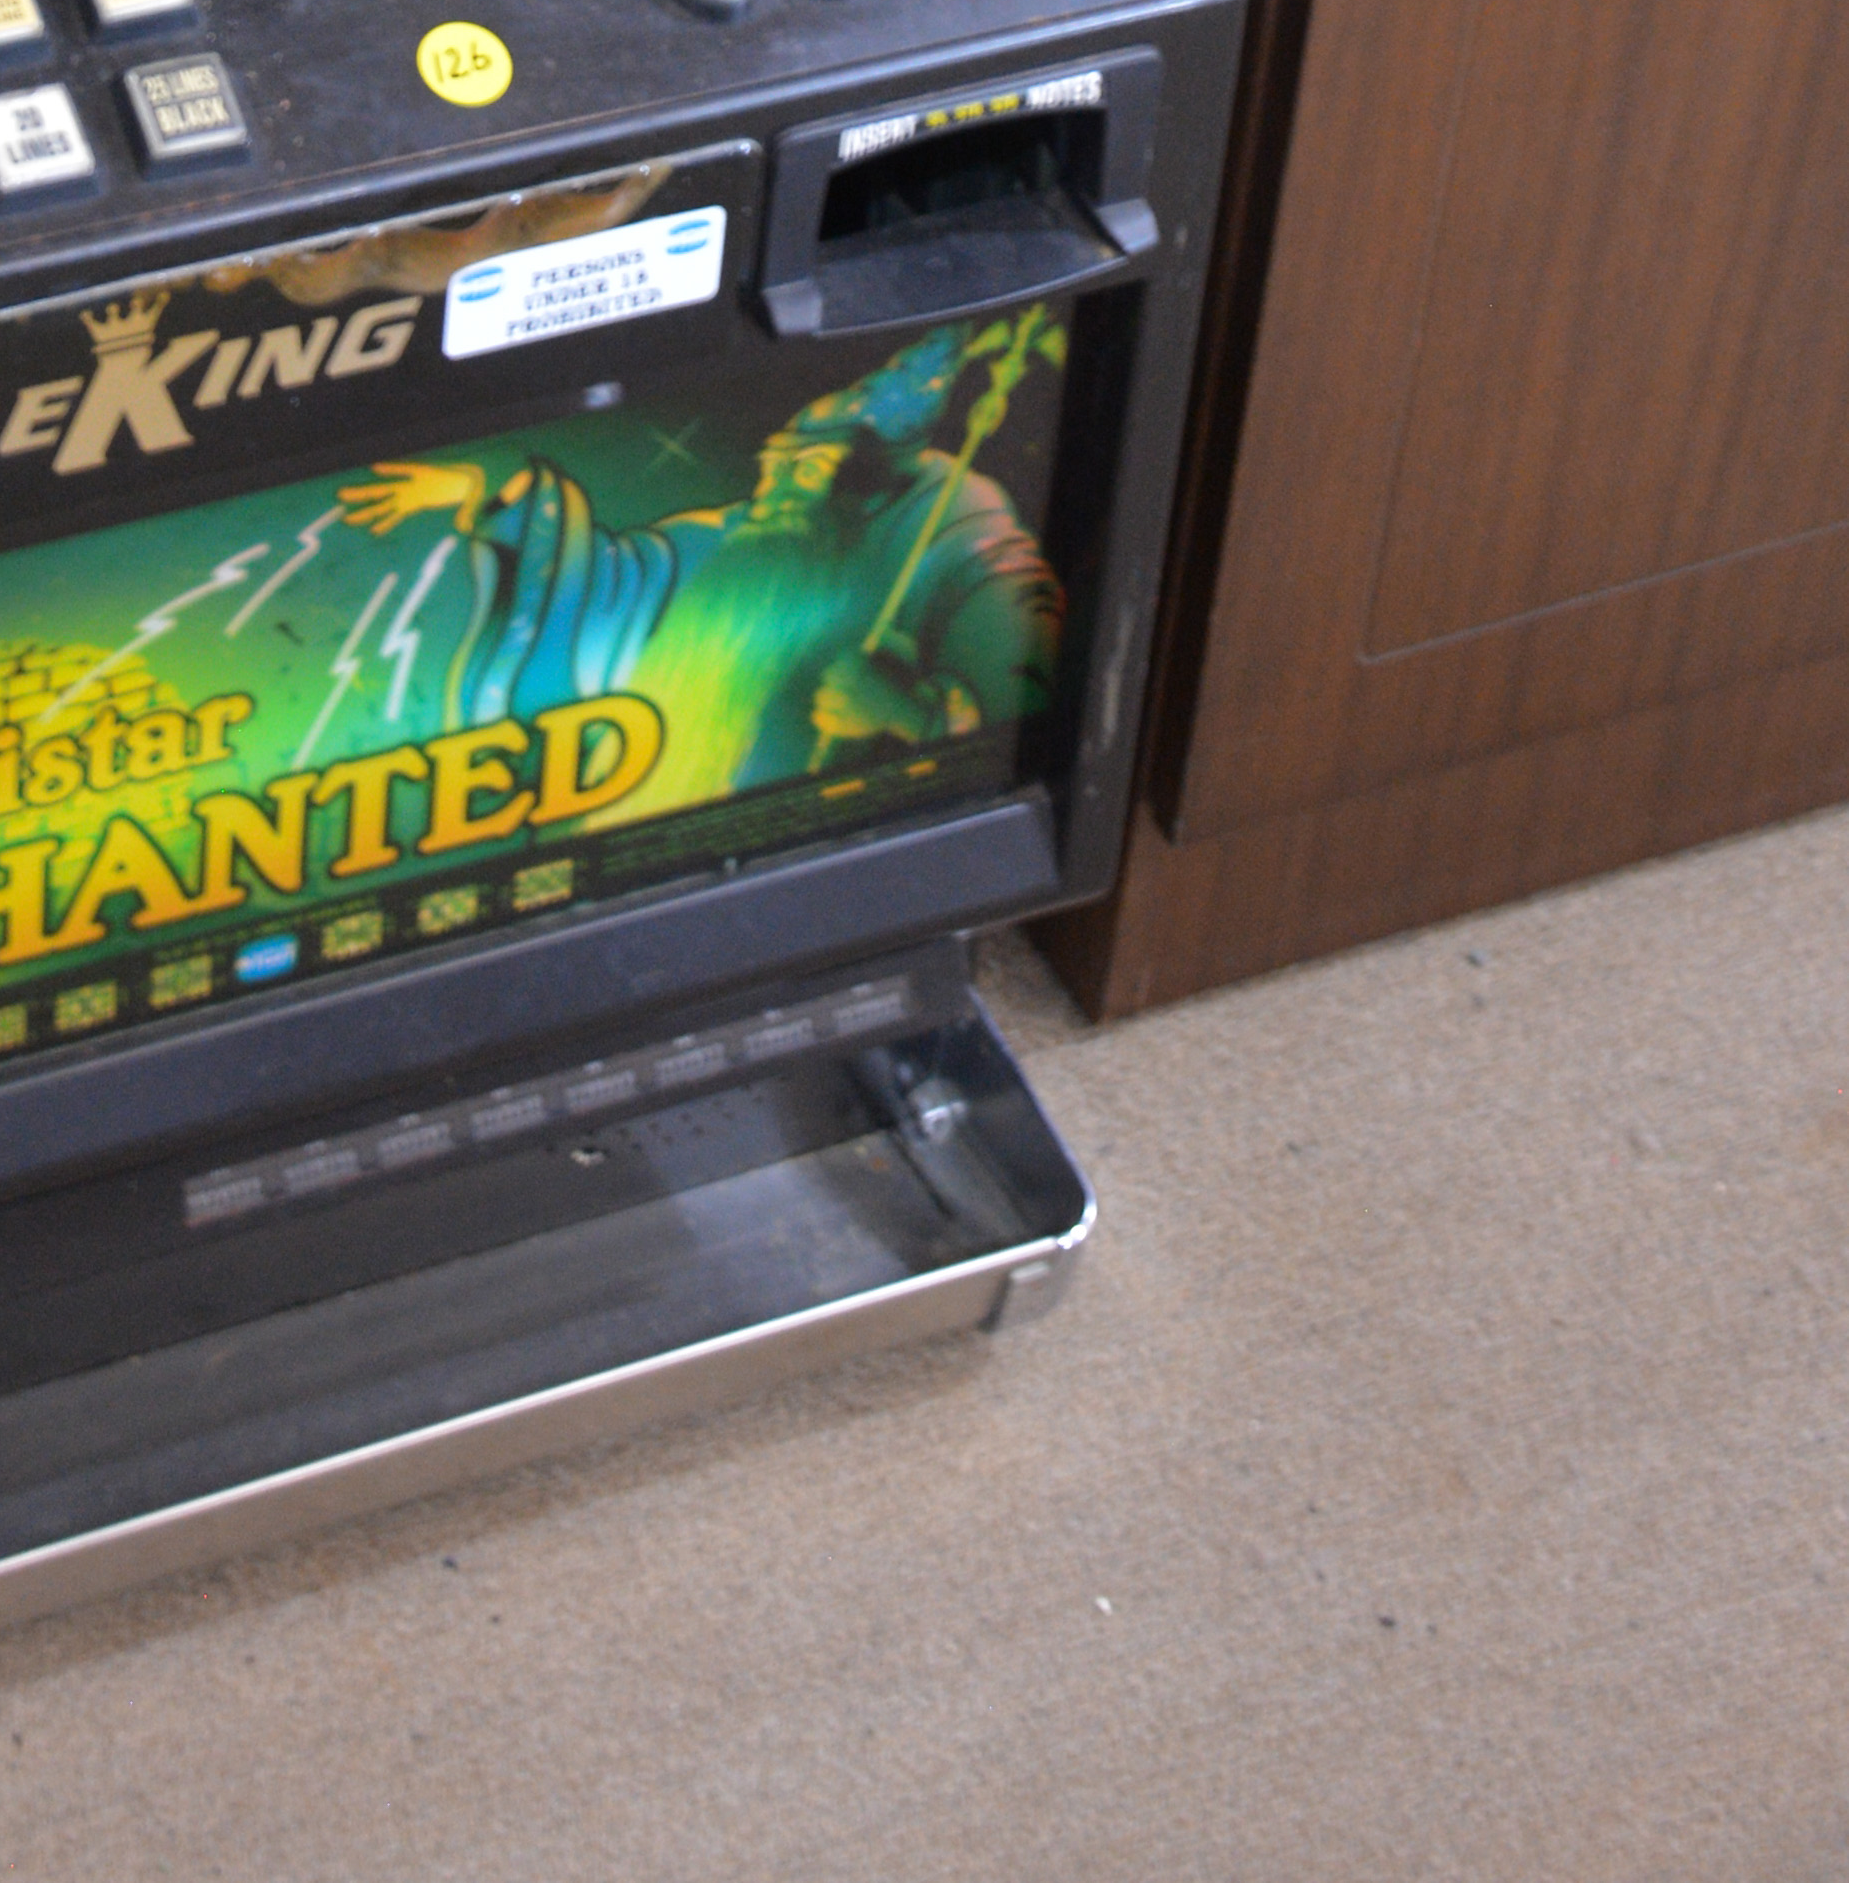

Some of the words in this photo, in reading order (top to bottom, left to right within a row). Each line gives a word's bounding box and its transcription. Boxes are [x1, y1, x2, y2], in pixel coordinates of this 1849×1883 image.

[433, 40, 492, 84] 126
[170, 64, 220, 97] LINES
[12, 105, 44, 131] 20
[839, 114, 918, 163] INSERT
[1025, 71, 1103, 109] NOTES
[6, 131, 72, 164] LINES
[531, 249, 646, 287] PERSONS
[505, 287, 662, 336] PROHIBITED
[524, 277, 608, 311] UNDER
